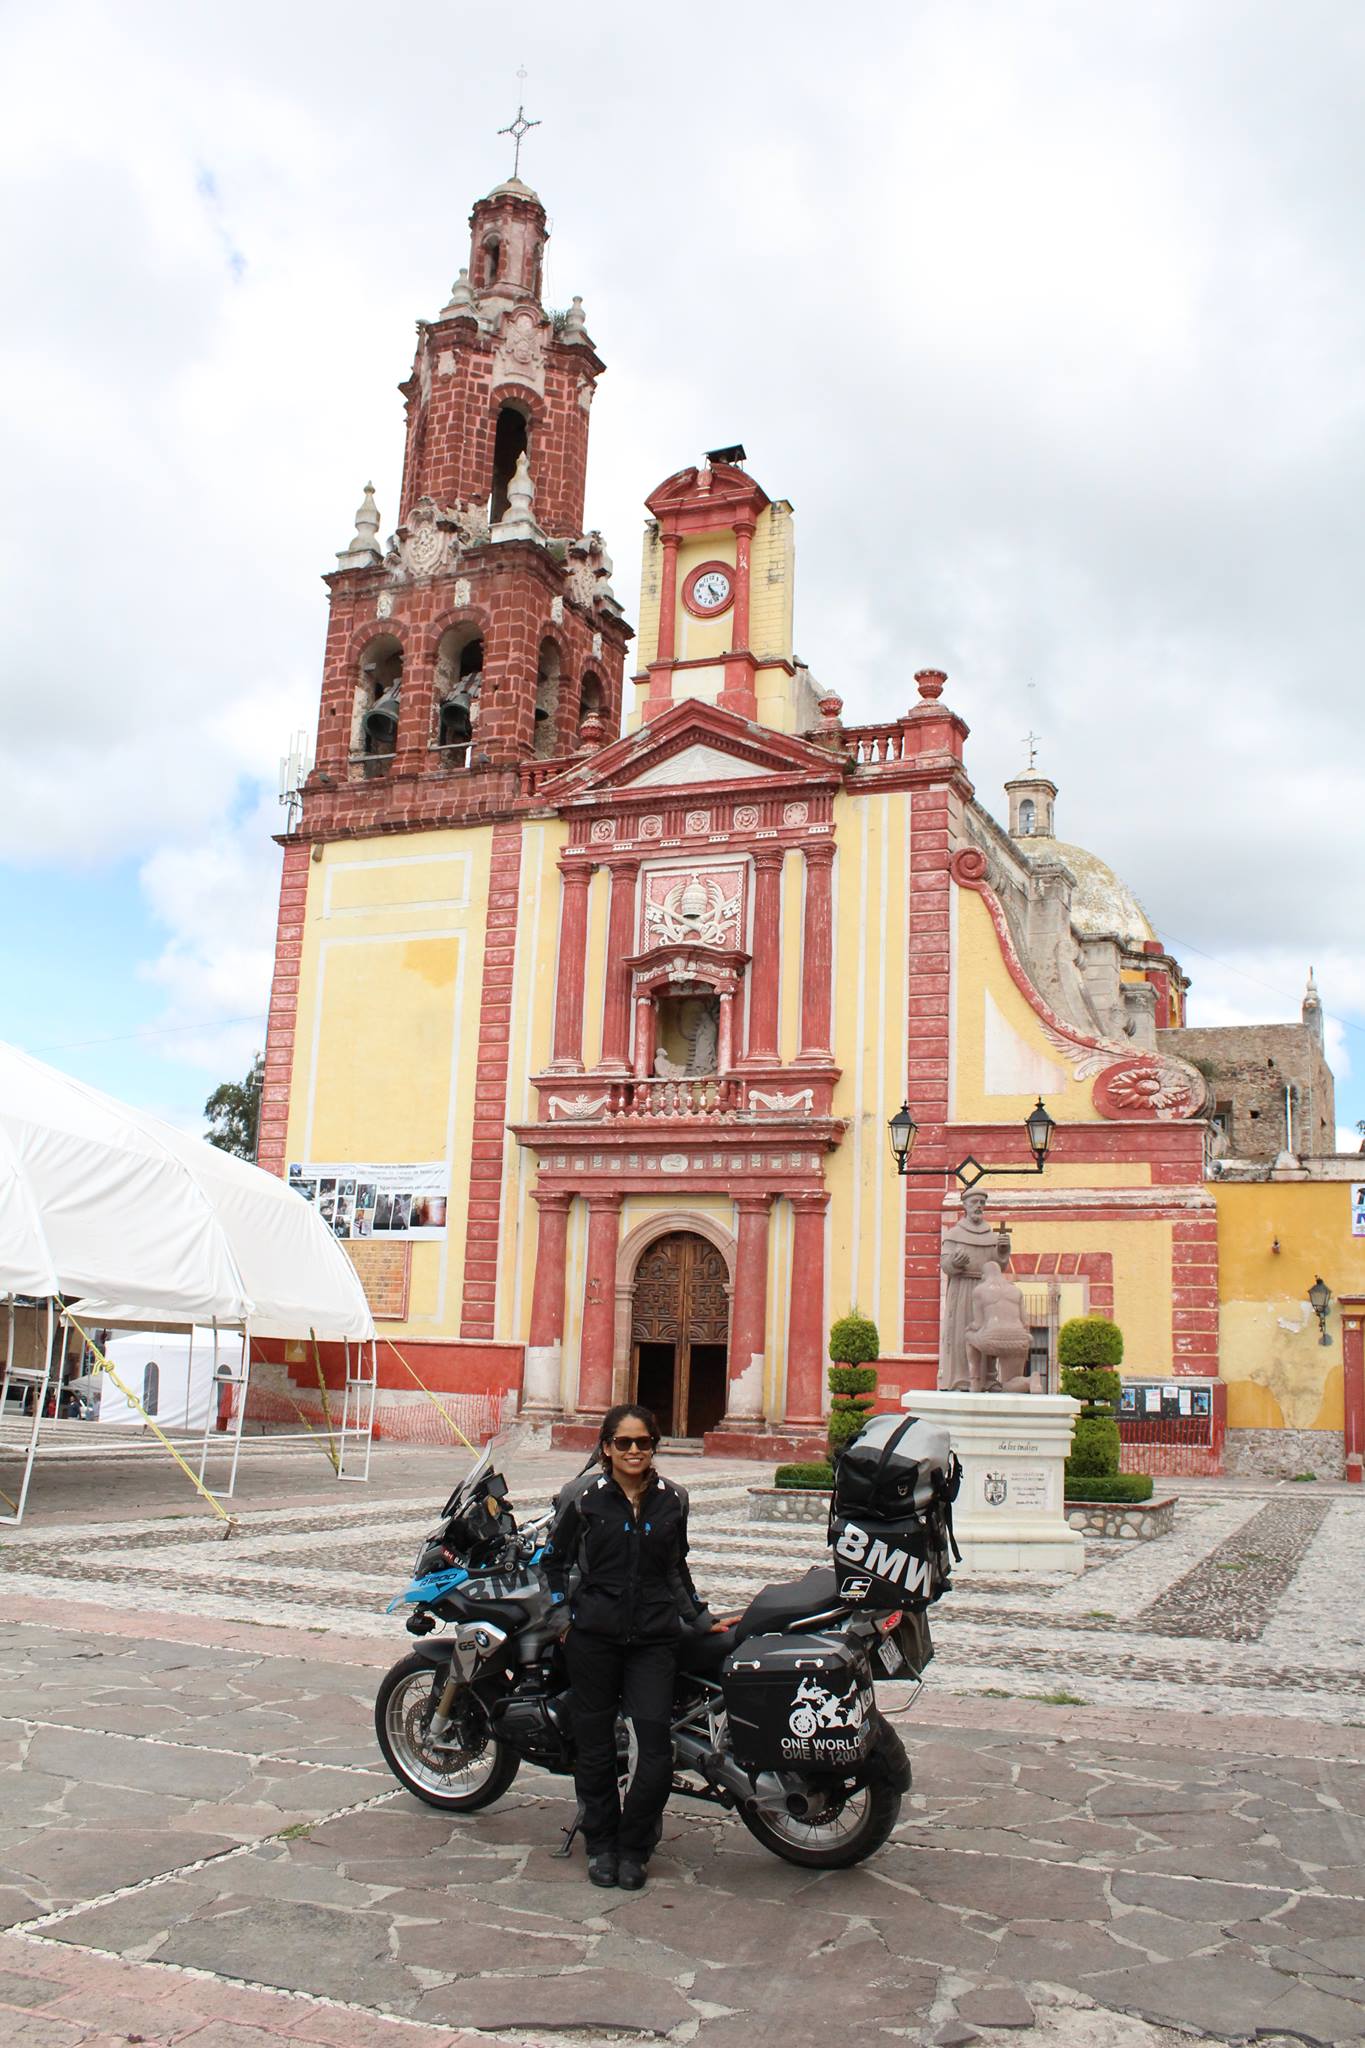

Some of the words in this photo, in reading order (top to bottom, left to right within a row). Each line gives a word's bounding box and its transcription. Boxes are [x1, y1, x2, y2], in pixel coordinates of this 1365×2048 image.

[836, 1523, 932, 1598] BMW
[458, 1641, 477, 1651] GS
[781, 1738, 810, 1749] ONE
[812, 1736, 860, 1751] WORLD
[815, 1750, 825, 1760] R
[828, 1748, 858, 1761] 1200
